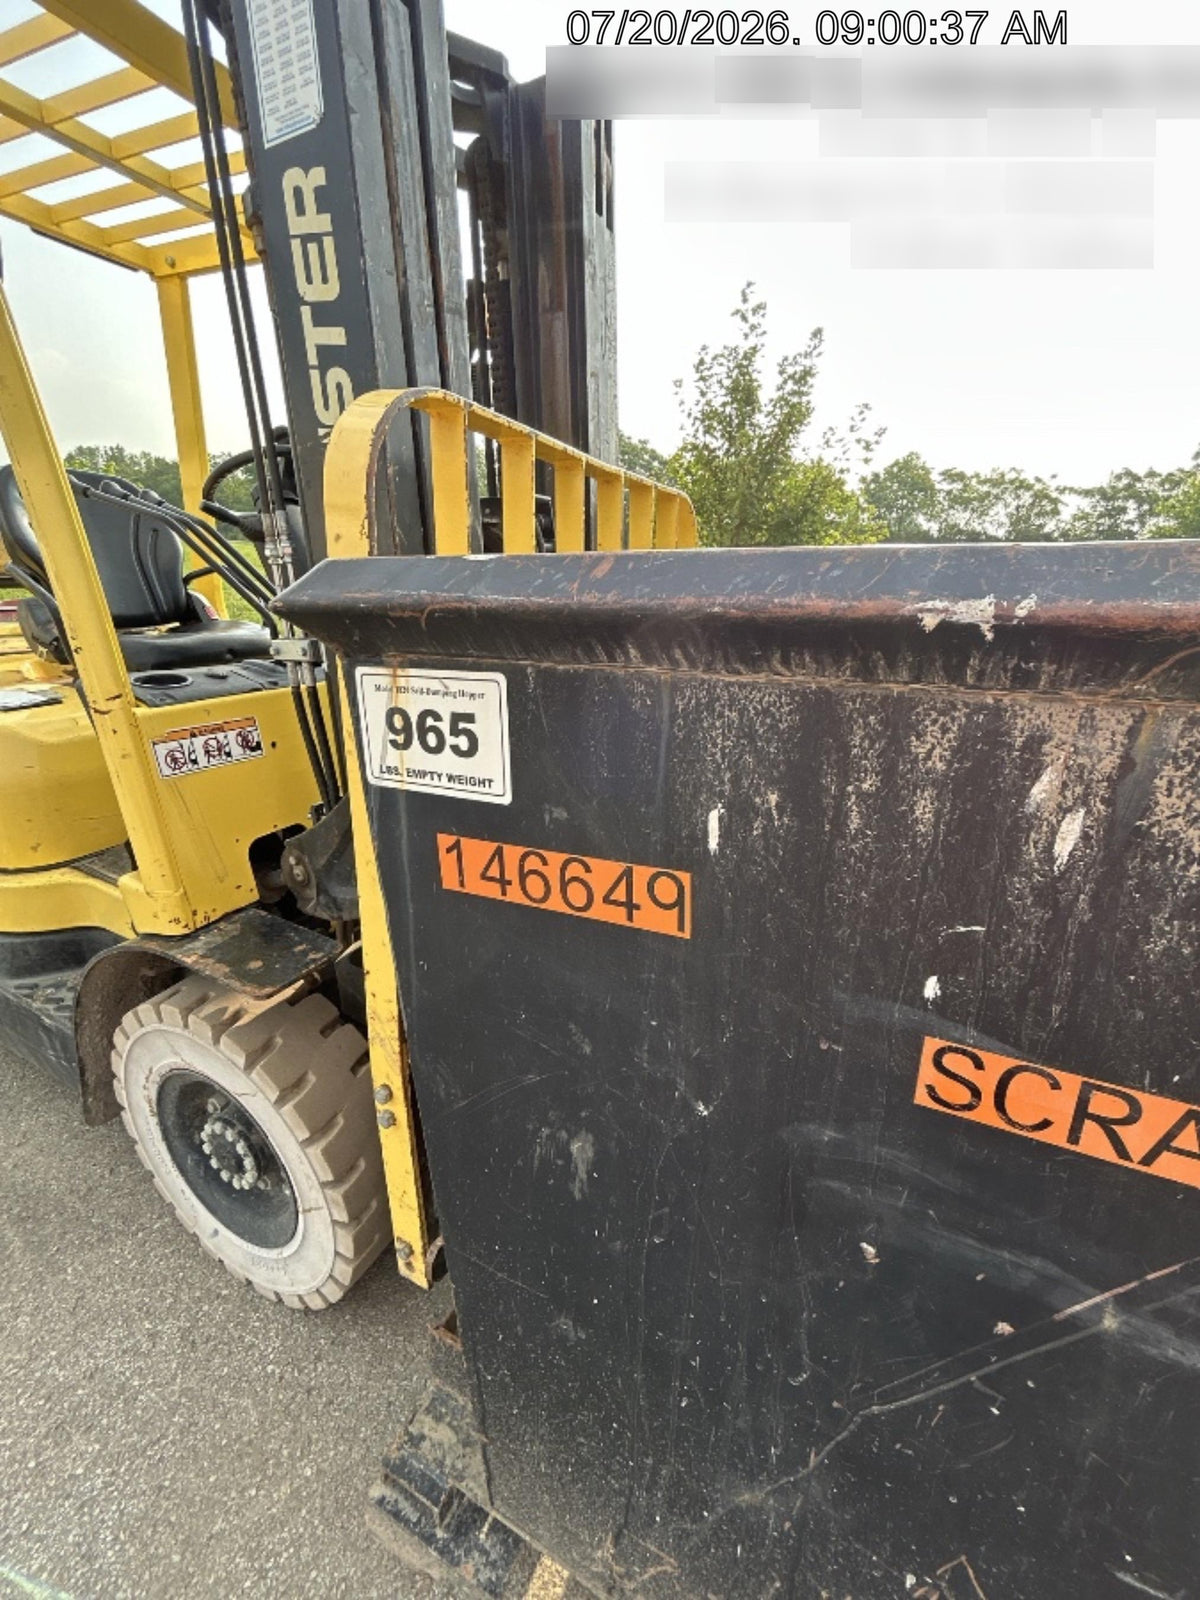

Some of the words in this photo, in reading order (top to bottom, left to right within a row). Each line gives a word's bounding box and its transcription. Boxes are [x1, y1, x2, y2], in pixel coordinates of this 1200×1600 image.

[282, 166, 355, 443] STER
[385, 706, 479, 759] 965
[405, 767, 443, 782] EMPTY
[446, 773, 494, 789] WEIGHT
[445, 838, 685, 933] 146649
